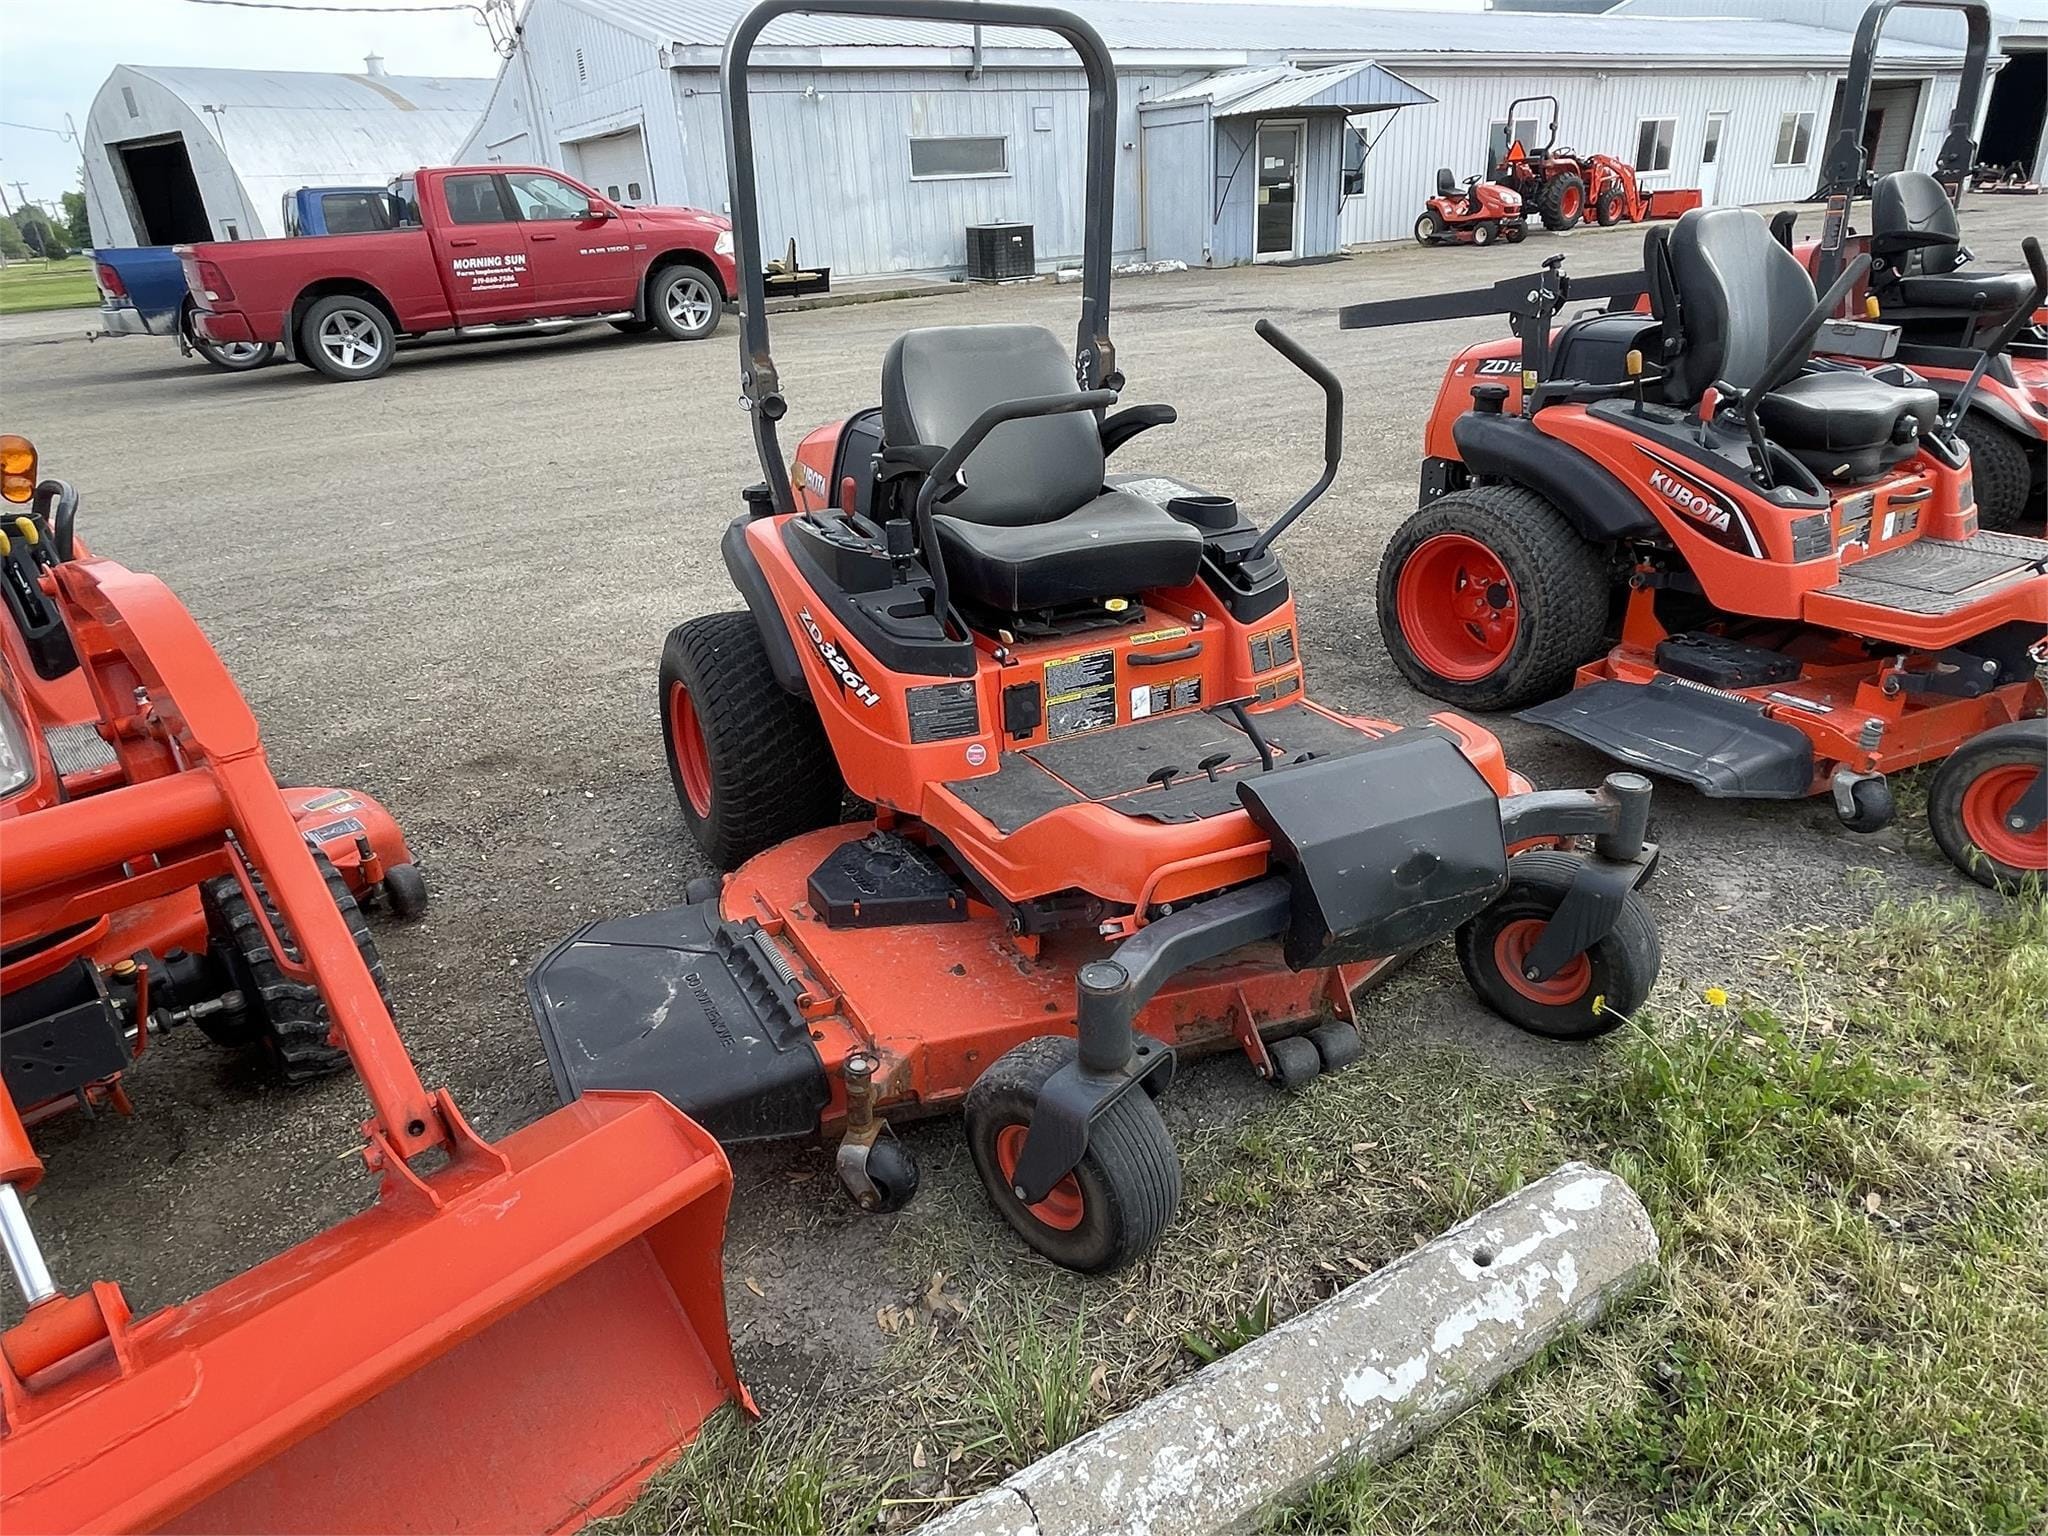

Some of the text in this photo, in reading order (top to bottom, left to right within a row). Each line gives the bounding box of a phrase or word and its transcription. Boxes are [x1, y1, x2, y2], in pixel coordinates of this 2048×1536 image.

[580, 247, 606, 255] RAM
[607, 245, 630, 253] 1500
[453, 254, 526, 270] MORNING SUN
[1480, 359, 1522, 373] ZD12
[1648, 469, 1732, 533] KUBOTA
[798, 605, 881, 707] ZD326H
